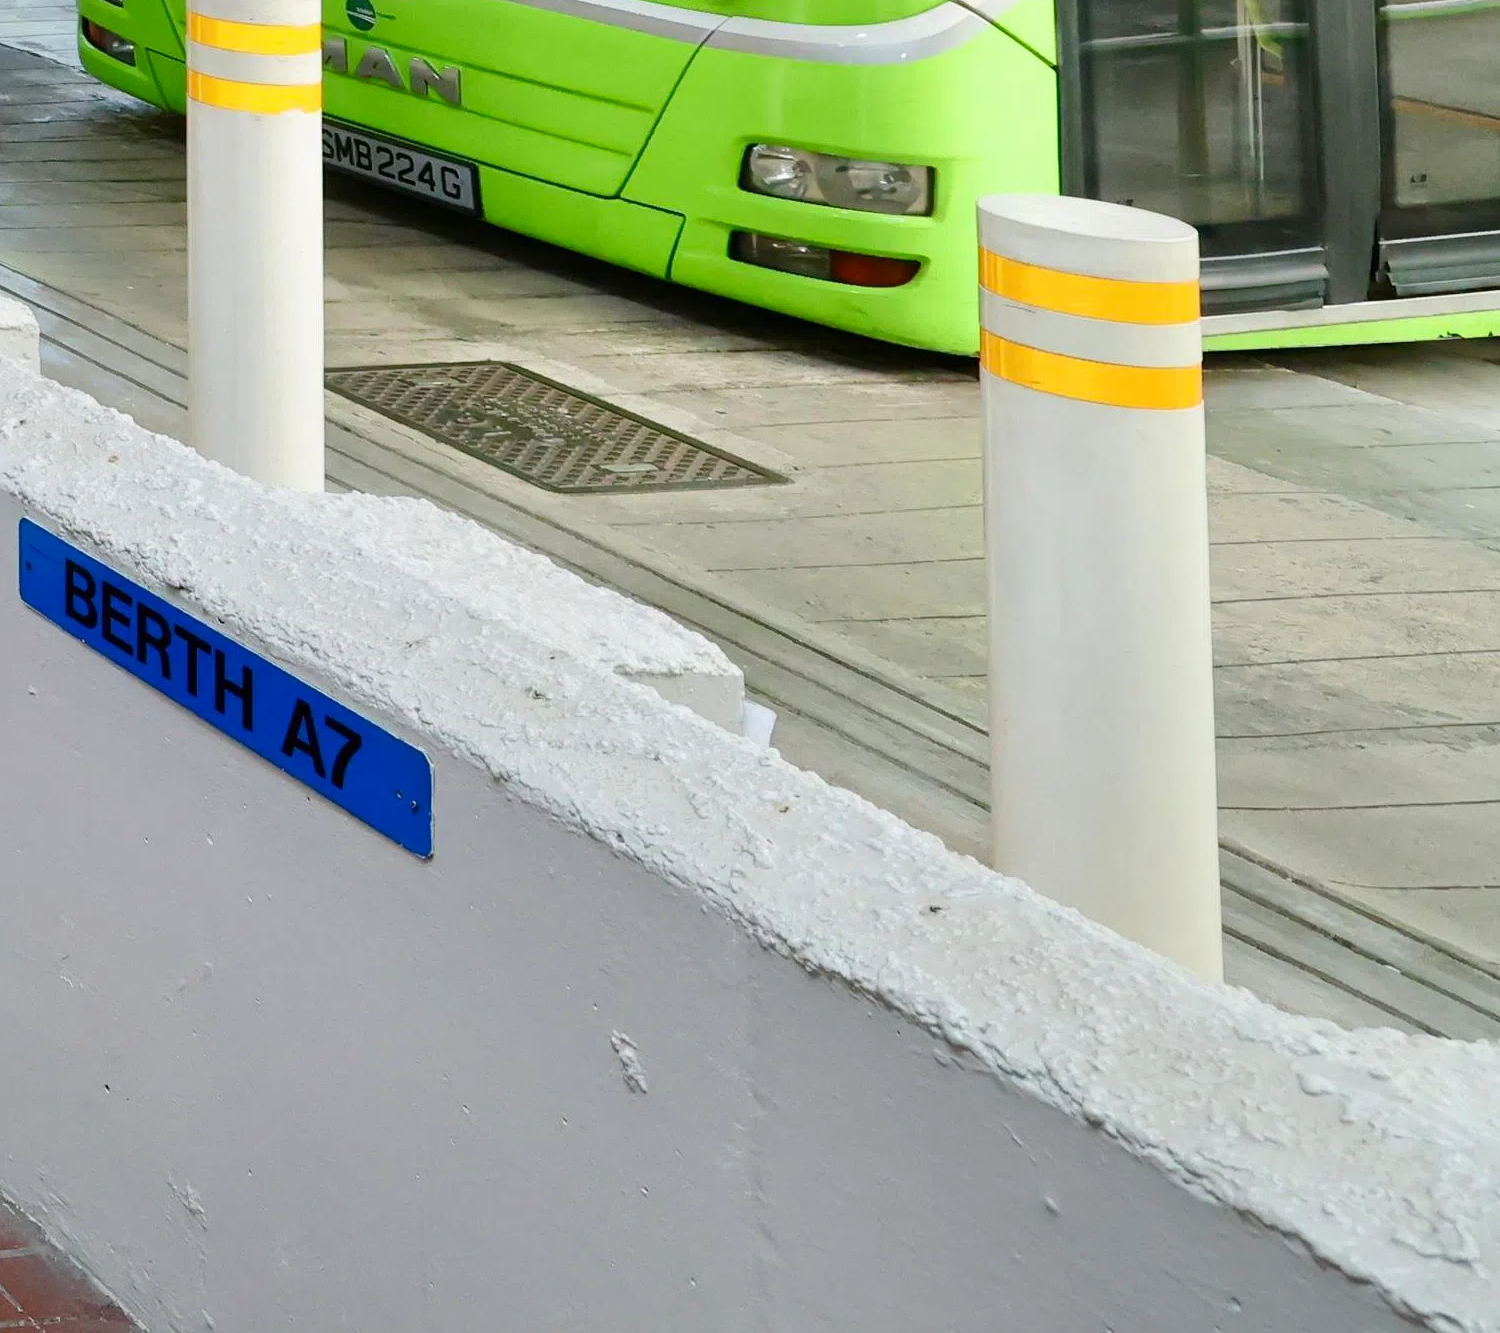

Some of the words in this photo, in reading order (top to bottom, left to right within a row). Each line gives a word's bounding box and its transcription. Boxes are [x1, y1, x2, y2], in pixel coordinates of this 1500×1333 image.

[322, 128, 461, 200] SMB224G
[64, 558, 253, 732] BERTH
[281, 698, 362, 790] A7
